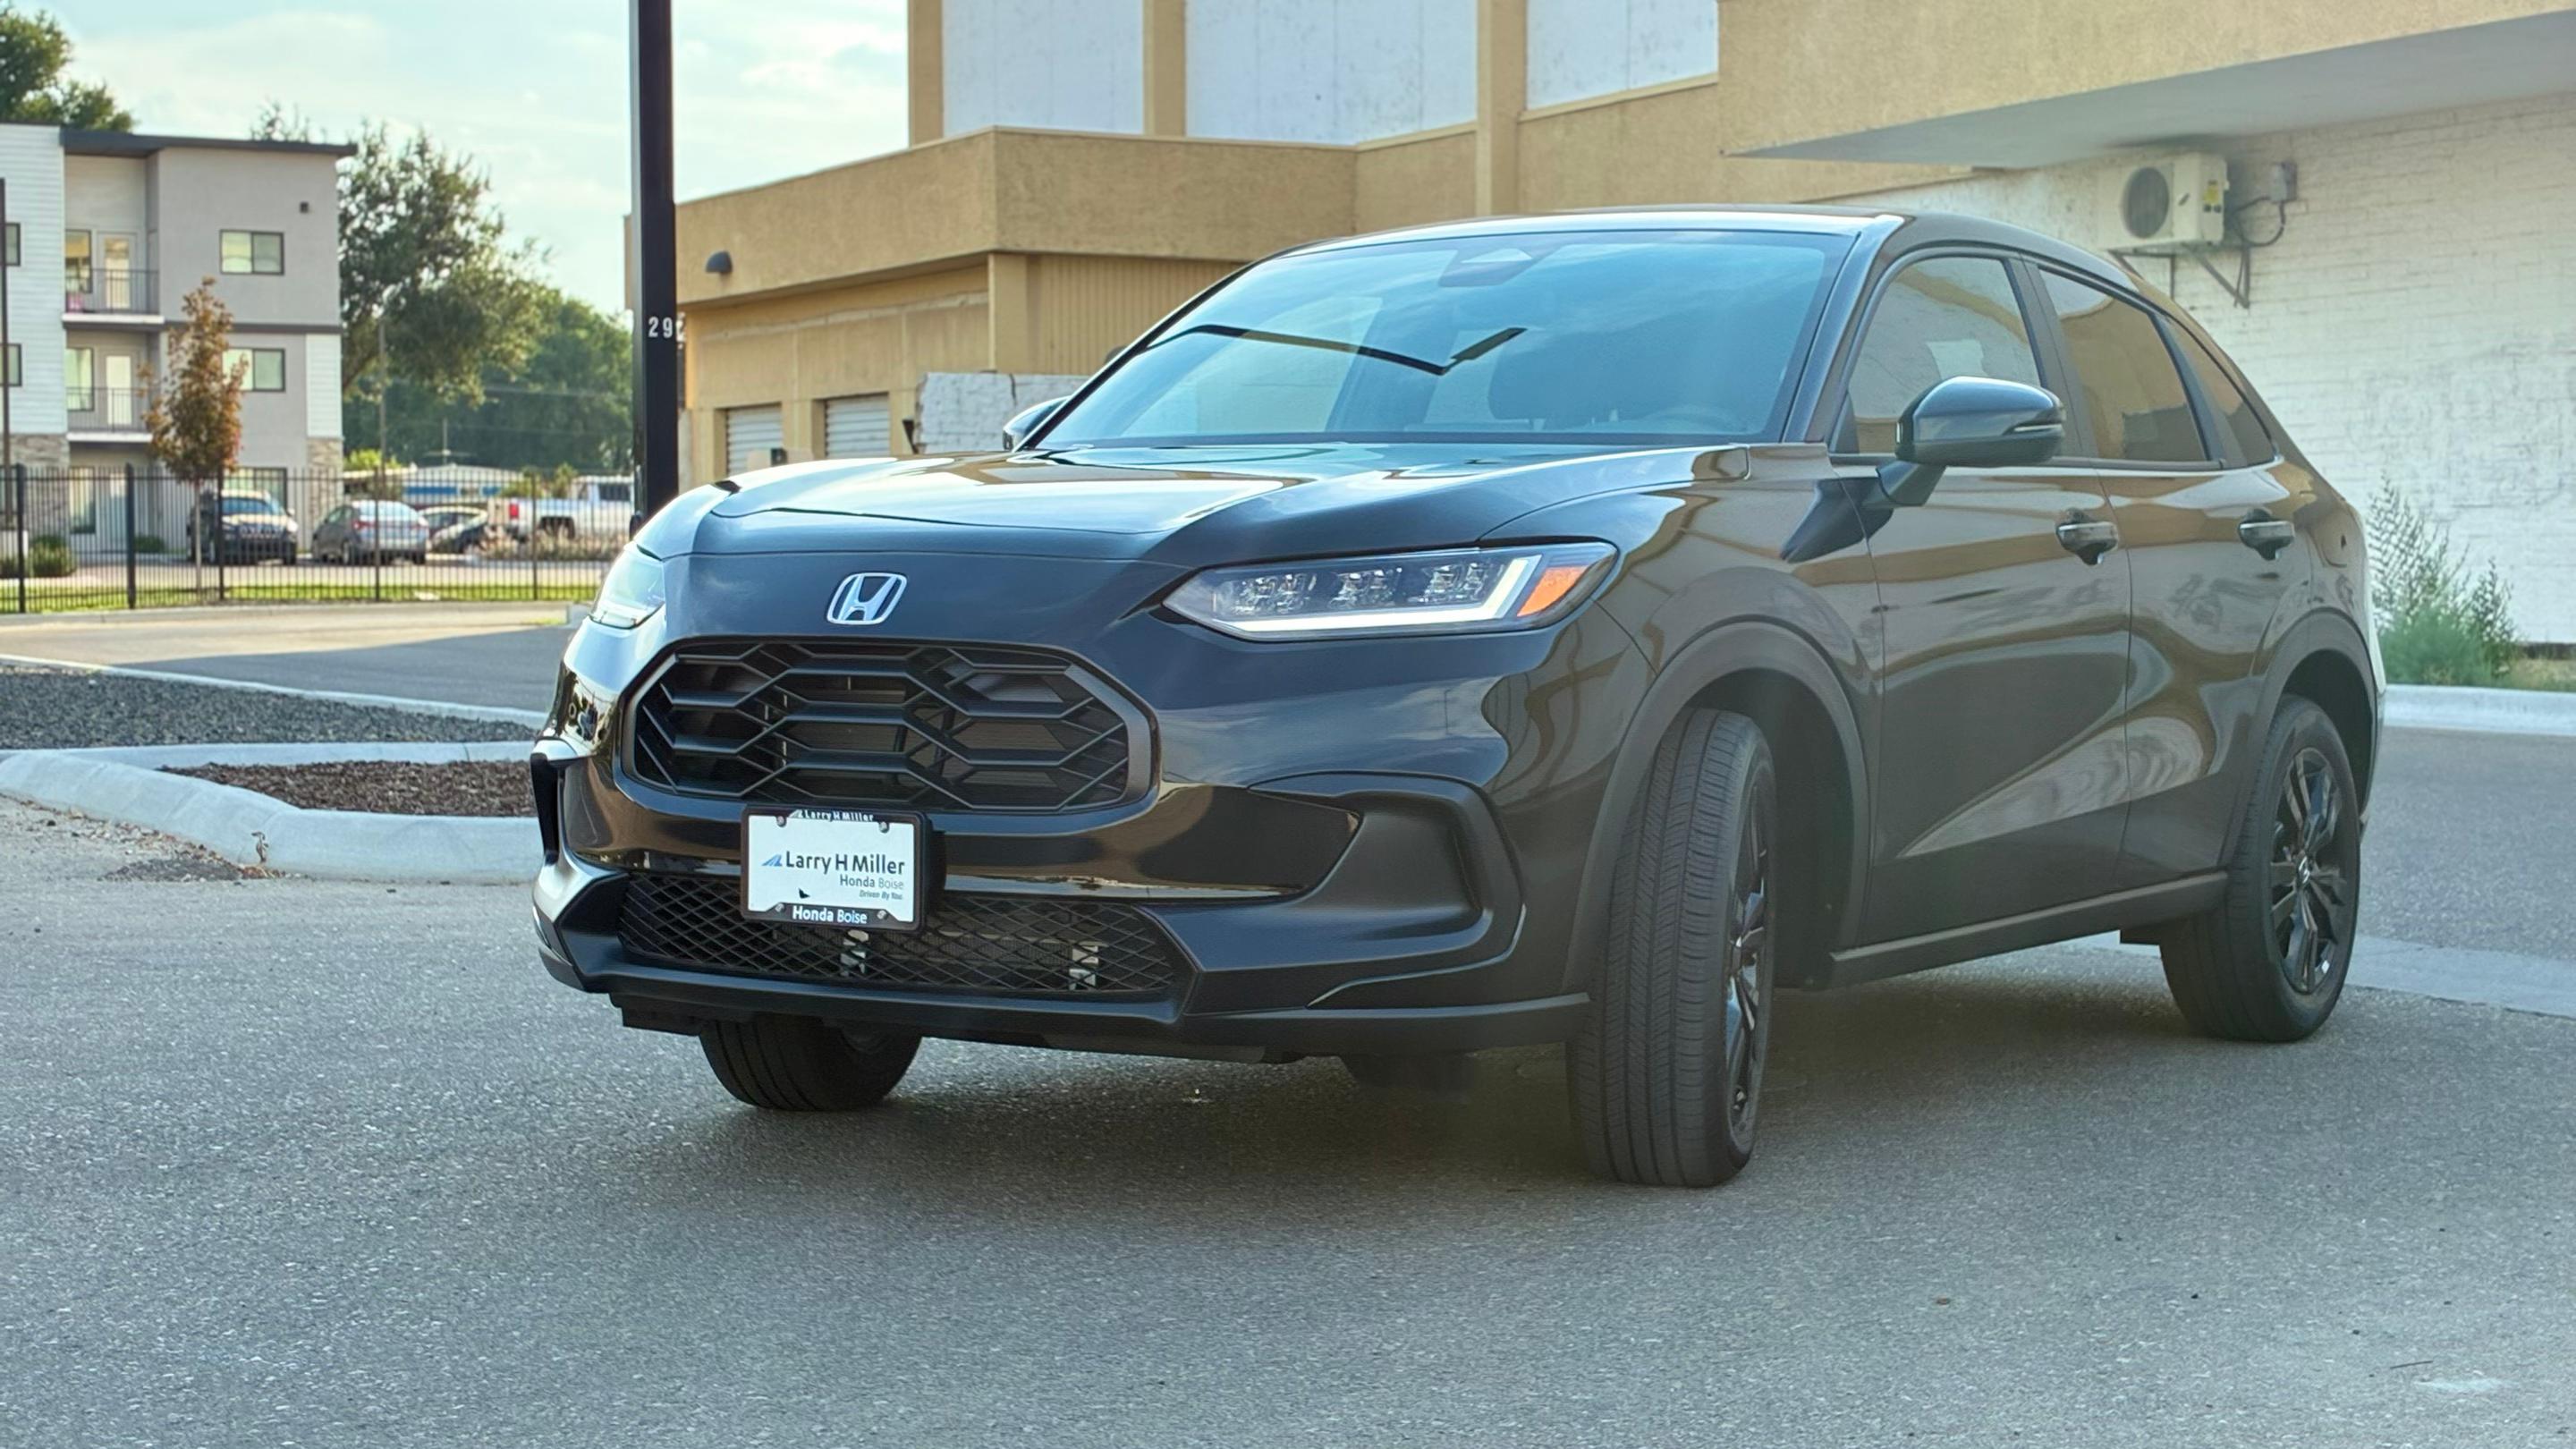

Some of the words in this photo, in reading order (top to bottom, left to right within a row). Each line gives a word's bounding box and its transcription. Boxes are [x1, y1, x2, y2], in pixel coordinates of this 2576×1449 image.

[804, 809, 832, 822] Larry
[833, 810, 841, 820] H
[842, 811, 875, 822] Miller
[785, 851, 832, 875] Larry
[835, 853, 848, 871] H
[852, 853, 905, 875] Miller
[840, 874, 876, 888] Honda
[878, 877, 904, 890] Boise
[792, 905, 834, 922] Honda
[837, 909, 868, 924] Boise
